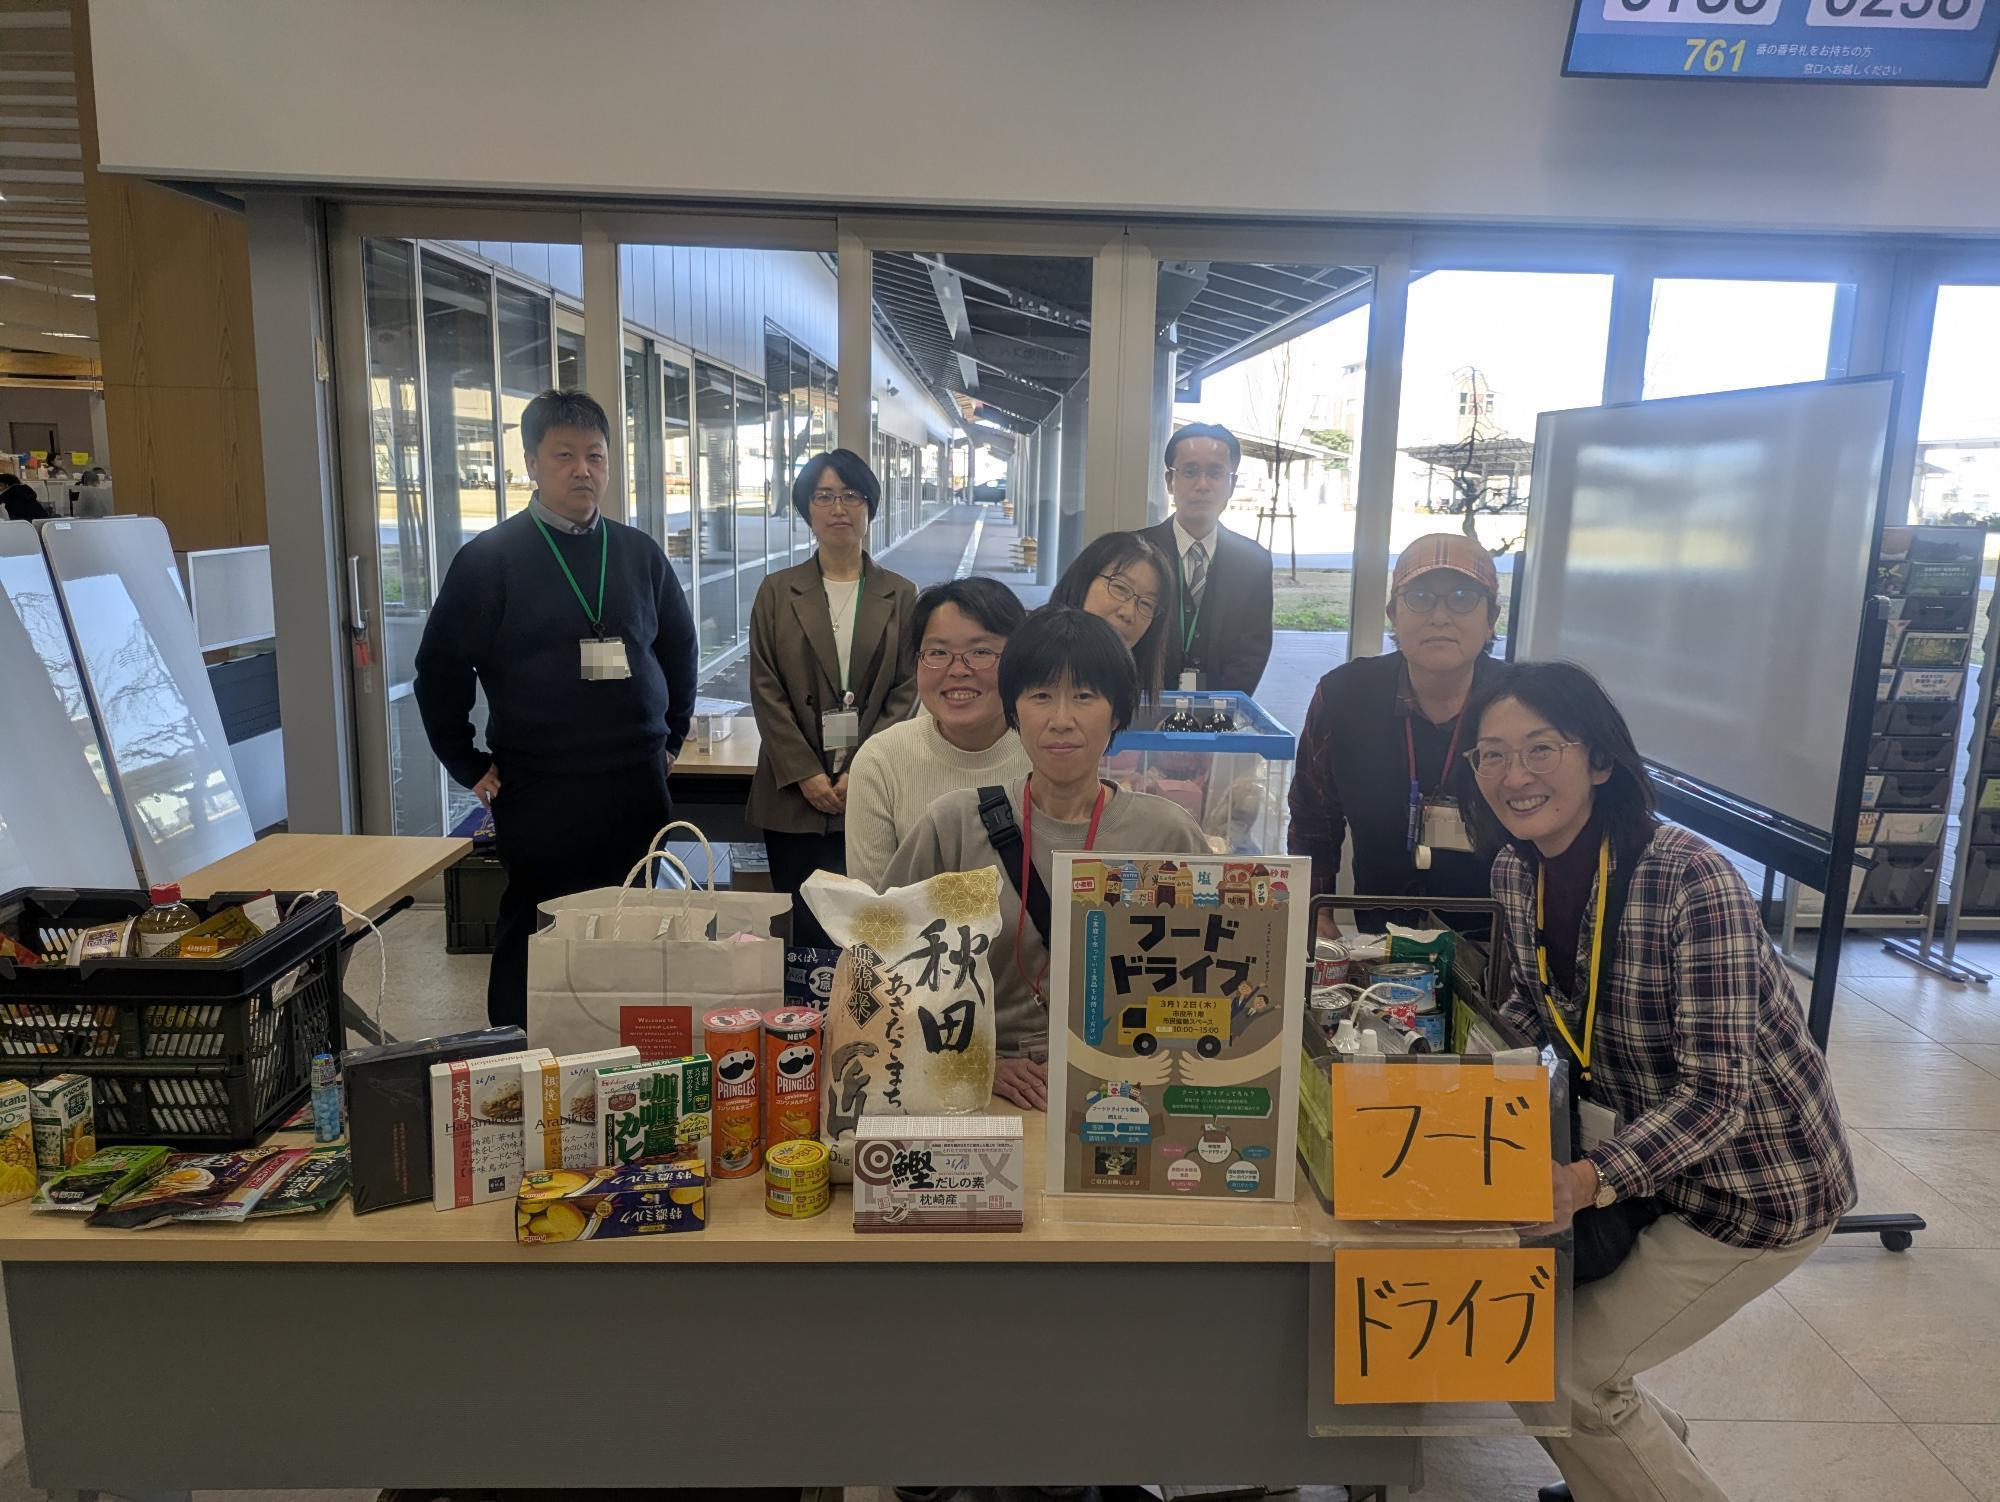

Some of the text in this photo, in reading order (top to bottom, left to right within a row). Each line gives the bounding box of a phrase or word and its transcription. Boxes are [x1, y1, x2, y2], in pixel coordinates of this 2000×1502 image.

[1682, 38, 1748, 73] 761
[1755, 43, 1873, 59] 番の番号札をお持ちの方
[1803, 62, 1902, 76] 窓口へお越しください
[1197, 871, 1212, 886] 塩
[1129, 913, 1240, 953] フード
[848, 945, 874, 1021] 無洗米
[885, 918, 990, 1055] 秋田
[1110, 954, 1257, 997] ドライブ
[786, 1032, 808, 1042] NEW
[882, 972, 913, 1109] あきたこまち
[453, 1080, 470, 1121] 華味鳥
[543, 1075, 557, 1115] 粗挽き
[717, 1077, 757, 1100] PRINGLES
[776, 1071, 816, 1094] PRINGLES
[534, 1111, 583, 1129] Arabiki
[1355, 1095, 1531, 1186] フード
[891, 1150, 937, 1190] 鰹
[934, 1176, 985, 1189] だしの素
[919, 1193, 958, 1206] 枕崎産
[1355, 1264, 1551, 1378] ドライブ
